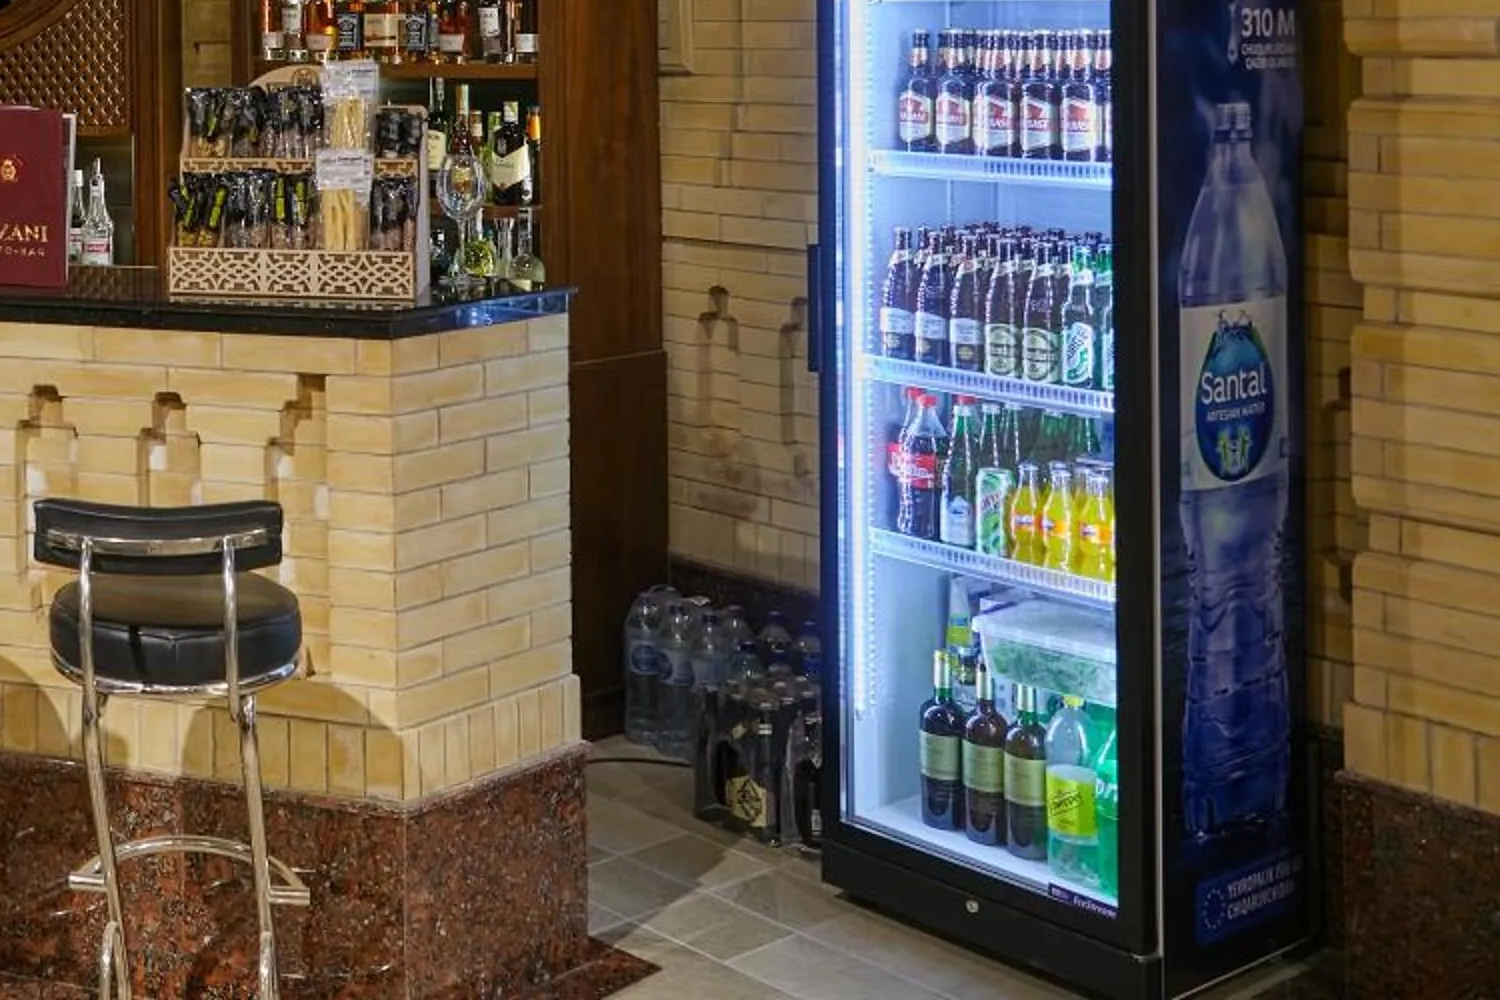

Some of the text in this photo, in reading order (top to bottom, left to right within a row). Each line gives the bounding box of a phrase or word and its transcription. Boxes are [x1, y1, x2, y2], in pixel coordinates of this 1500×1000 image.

[1241, 7, 1296, 37] 310 M
[1201, 362, 1268, 405] Santal
